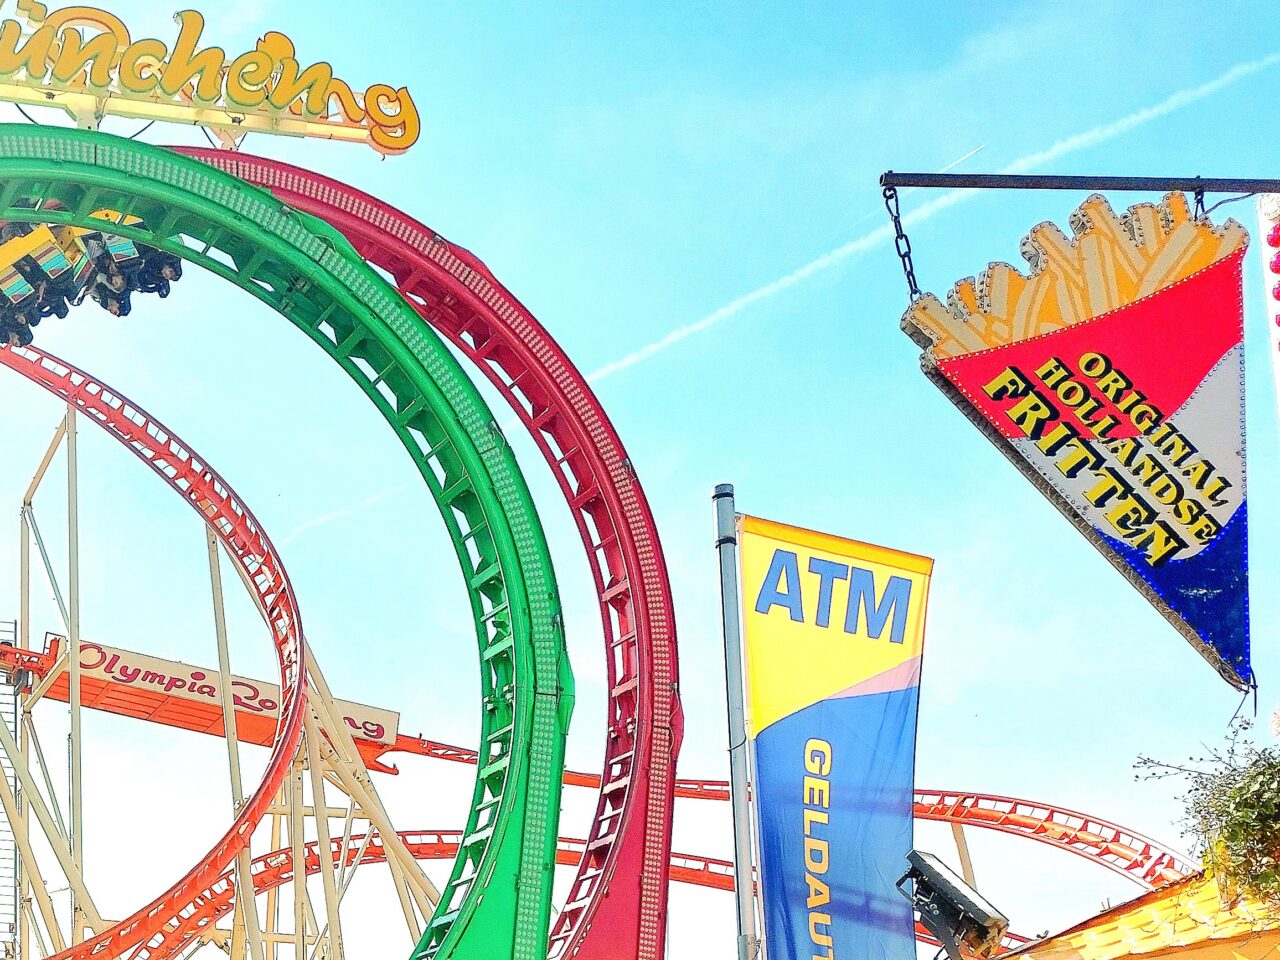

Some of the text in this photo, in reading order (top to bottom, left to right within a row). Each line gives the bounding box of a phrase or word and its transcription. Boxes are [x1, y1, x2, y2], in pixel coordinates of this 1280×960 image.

[980, 366, 1189, 568] FRITTEN
[1034, 356, 1223, 545] HOLLANDSE
[1077, 351, 1234, 508] ORIGINAL
[79, 643, 217, 698] Olympia
[755, 547, 913, 645] ATM
